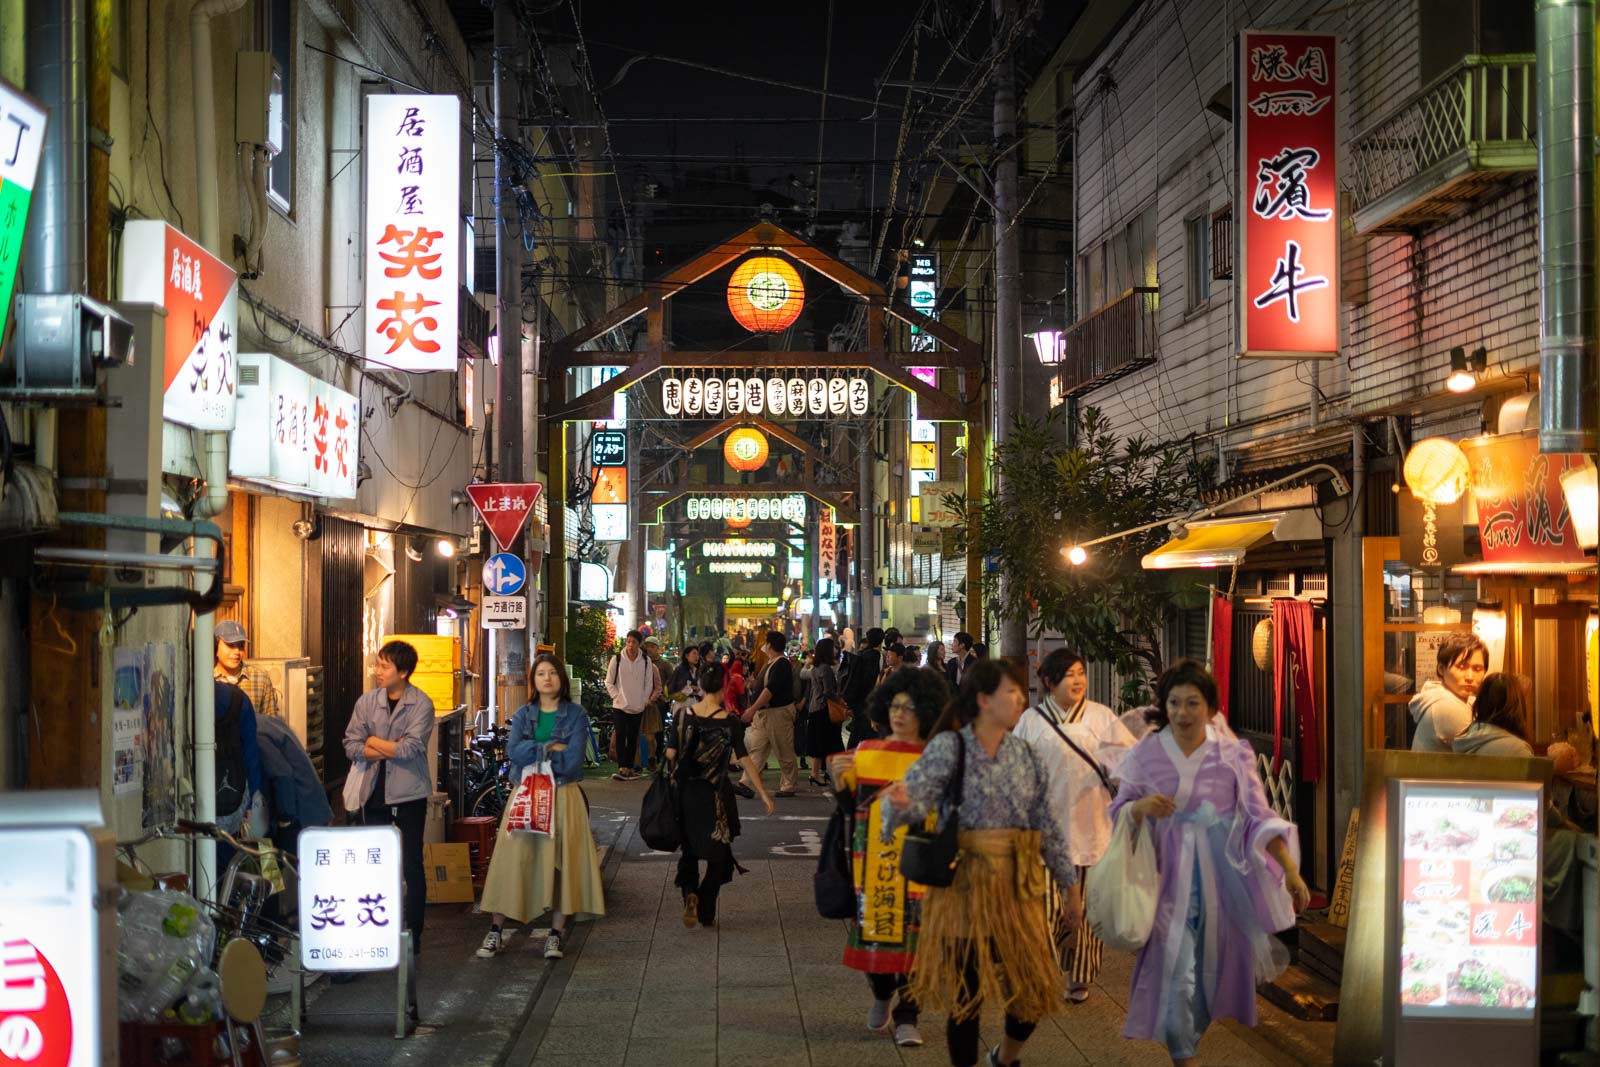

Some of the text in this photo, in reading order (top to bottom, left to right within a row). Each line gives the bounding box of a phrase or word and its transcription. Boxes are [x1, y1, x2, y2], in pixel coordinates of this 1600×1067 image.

[1251, 45, 1328, 84] 焼肉
[1248, 90, 1332, 117] ホルモン
[396, 107, 425, 216] 居酒屋
[169, 247, 203, 301] 居酒屋
[688, 379, 700, 411] もも
[727, 381, 740, 411] HUG
[809, 380, 823, 411] ゆき
[852, 381, 867, 411] みち
[274, 394, 308, 452] 居酒屋
[482, 496, 528, 512] 止まれ
[485, 601, 523, 613] 一方通行路
